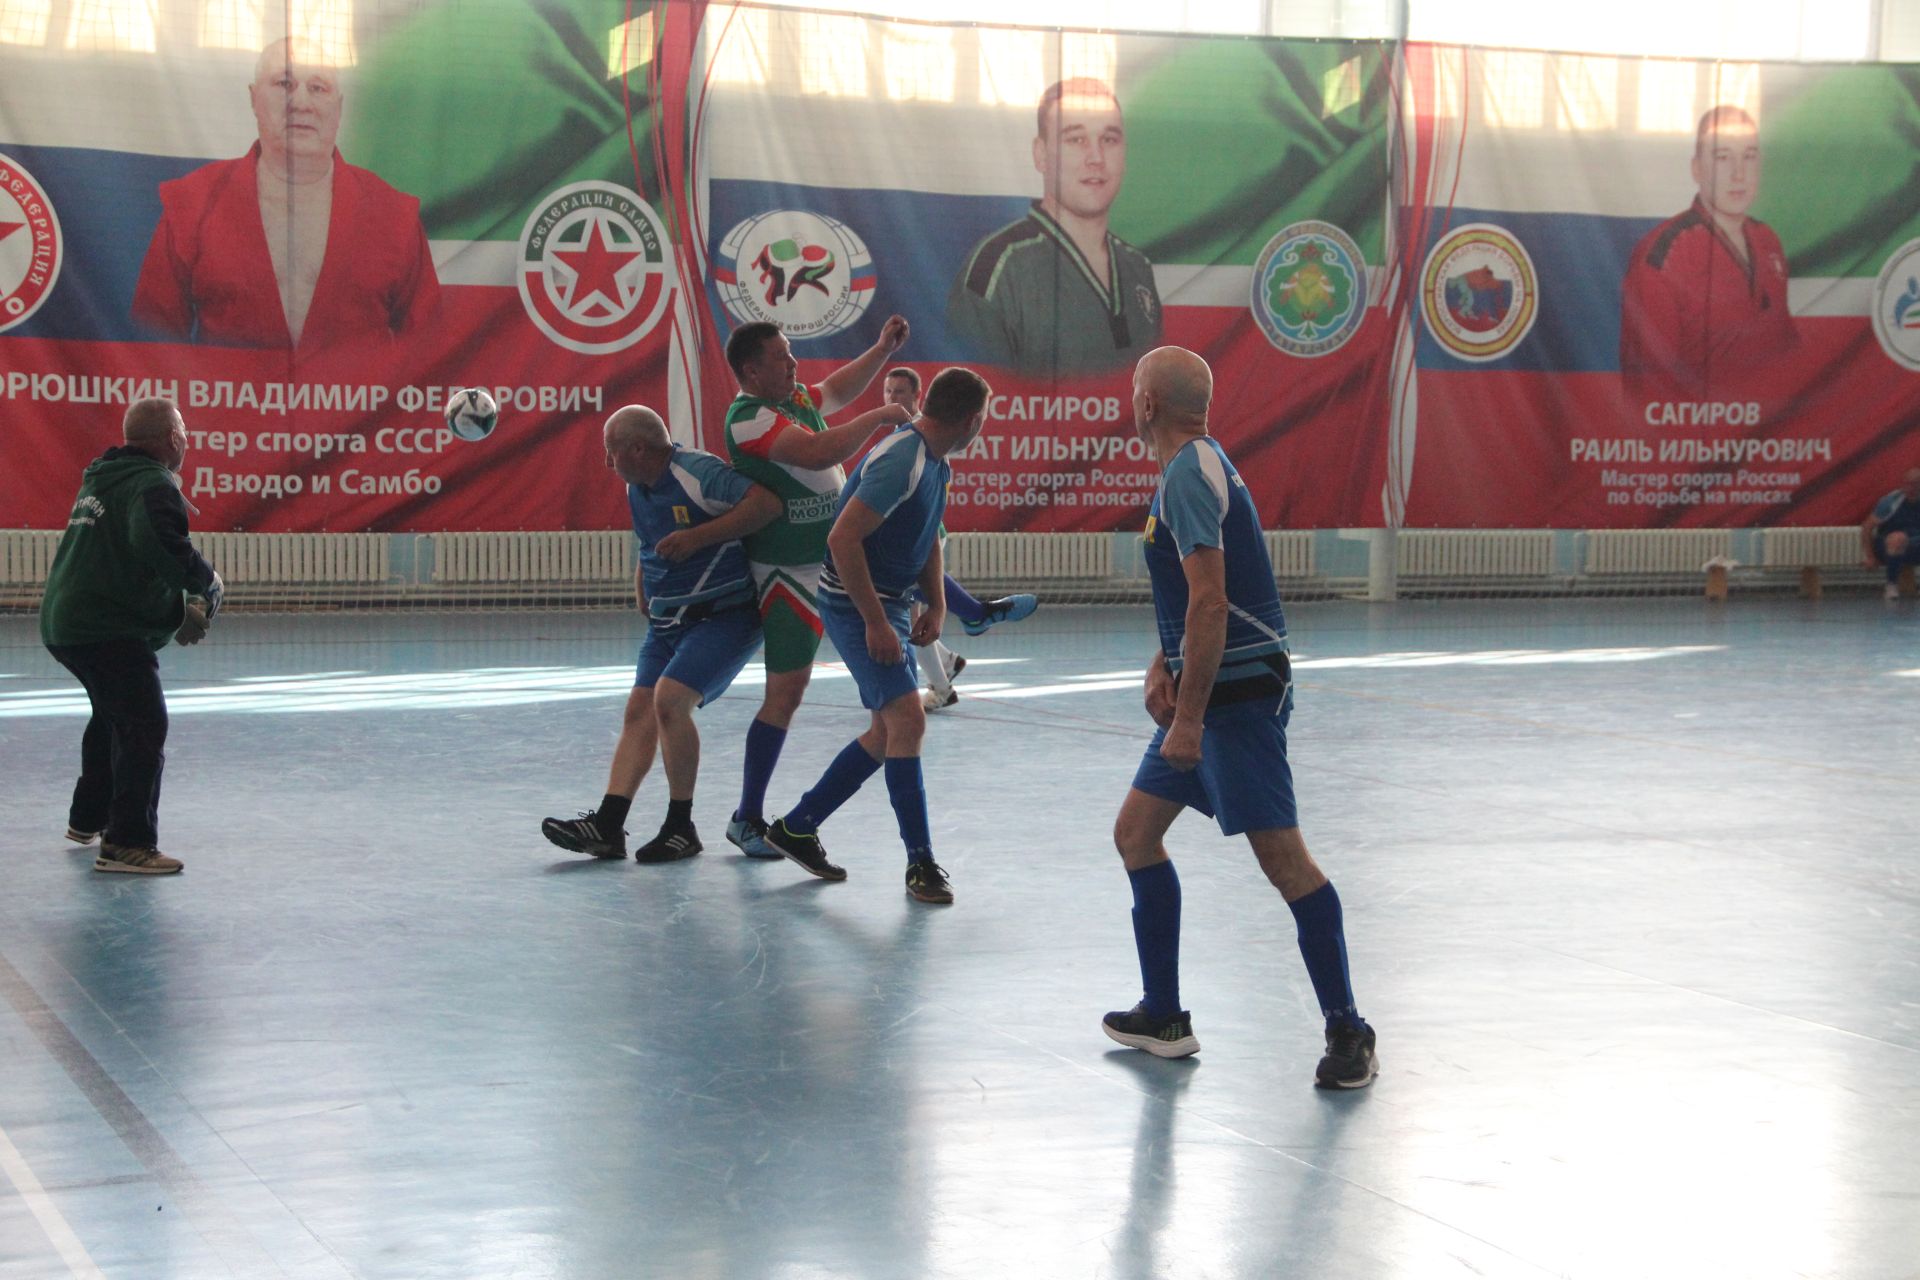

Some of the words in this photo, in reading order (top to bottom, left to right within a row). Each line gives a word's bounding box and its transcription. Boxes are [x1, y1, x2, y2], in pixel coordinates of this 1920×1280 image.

[532, 192, 613, 249] ФЕДЕРАЦИЯ
[619, 201, 656, 250] САМБО
[823, 285, 849, 321] РОССИИ
[189, 380, 388, 415] ВЛАДИМИР
[396, 385, 603, 413] ФЕРОВИЧ
[989, 395, 1120, 422] САГИРОВ
[1645, 401, 1760, 425] САГИРОВ
[256, 431, 366, 459] спорта
[374, 427, 453, 453] СССР
[1570, 438, 1653, 462] РАИЛЬ
[1659, 438, 1832, 463] ИЛЬНУРОВИЧ
[191, 467, 303, 499] Дзюдо
[311, 475, 330, 494] и
[339, 468, 442, 495] Самбо
[1016, 472, 1086, 491] спорта
[1601, 469, 1668, 491] Мастер
[1672, 473, 1732, 491] спорта
[1736, 469, 1800, 487] России
[973, 487, 1049, 510] борьбе
[1053, 492, 1077, 506] на
[1083, 492, 1152, 506] поясах
[1607, 491, 1629, 505] по
[1633, 488, 1700, 509] борьбе
[1704, 490, 1726, 504] на
[1729, 490, 1792, 504] поясах
